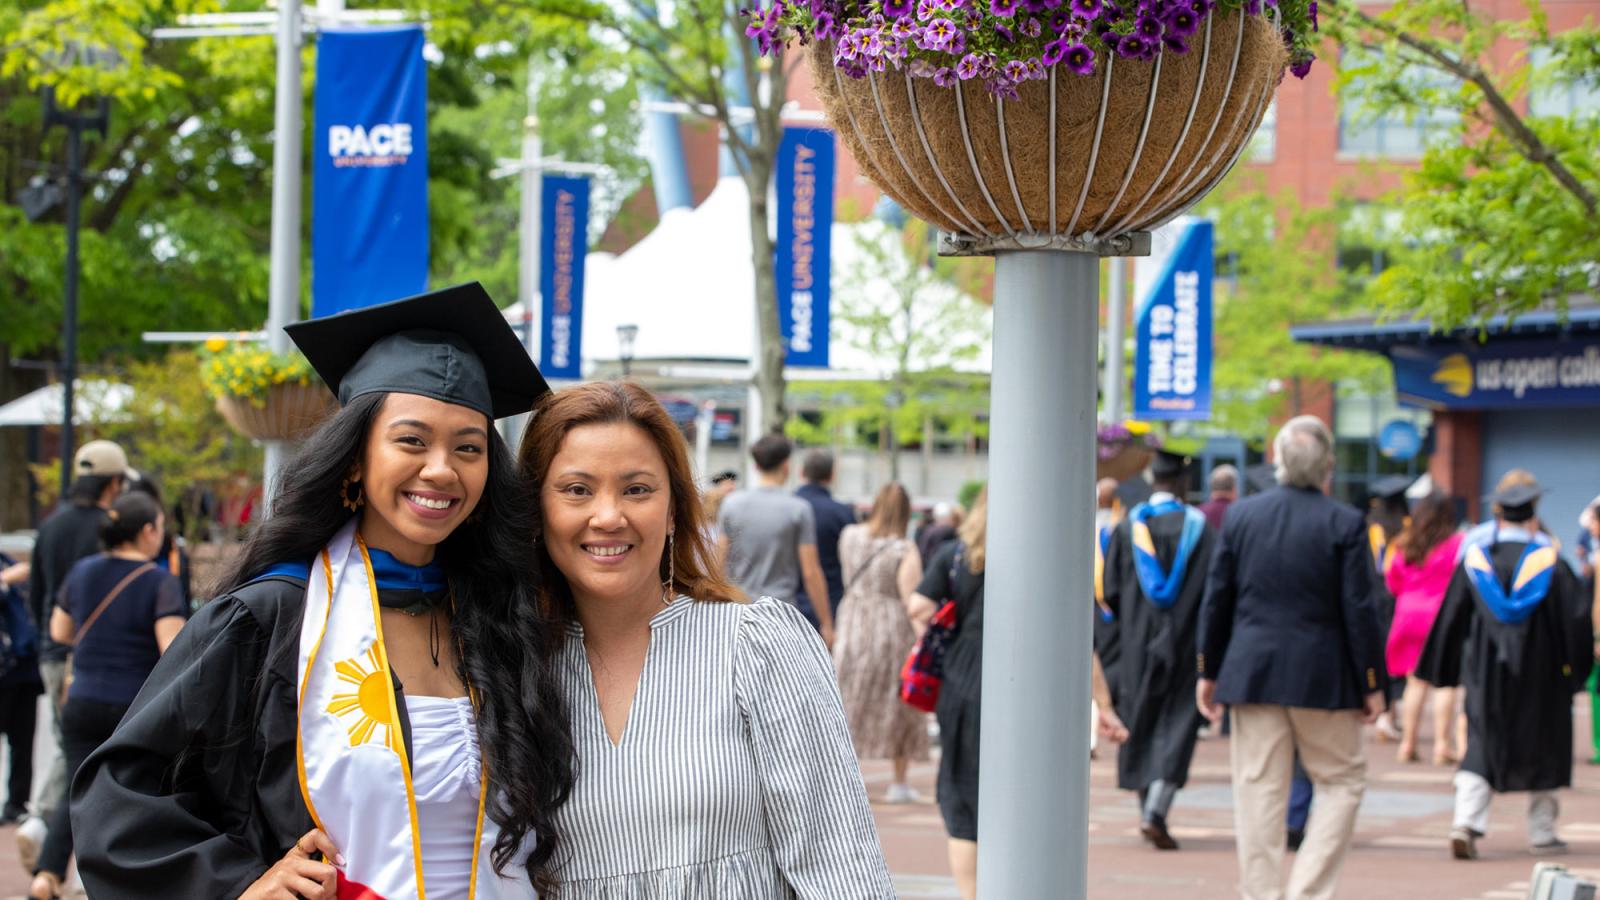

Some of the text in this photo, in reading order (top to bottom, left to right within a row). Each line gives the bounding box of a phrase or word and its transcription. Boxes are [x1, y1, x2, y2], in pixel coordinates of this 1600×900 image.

[328, 123, 413, 156] PACE
[790, 144, 816, 352] PACE UNIVERSITY
[552, 189, 575, 368] PACE UNIVERSITY
[1150, 304, 1175, 336] TO
[1173, 270, 1199, 395] CELEBRATE
[1148, 338, 1174, 394] TIME
[1476, 359, 1501, 390] us
[1503, 357, 1557, 399] open
